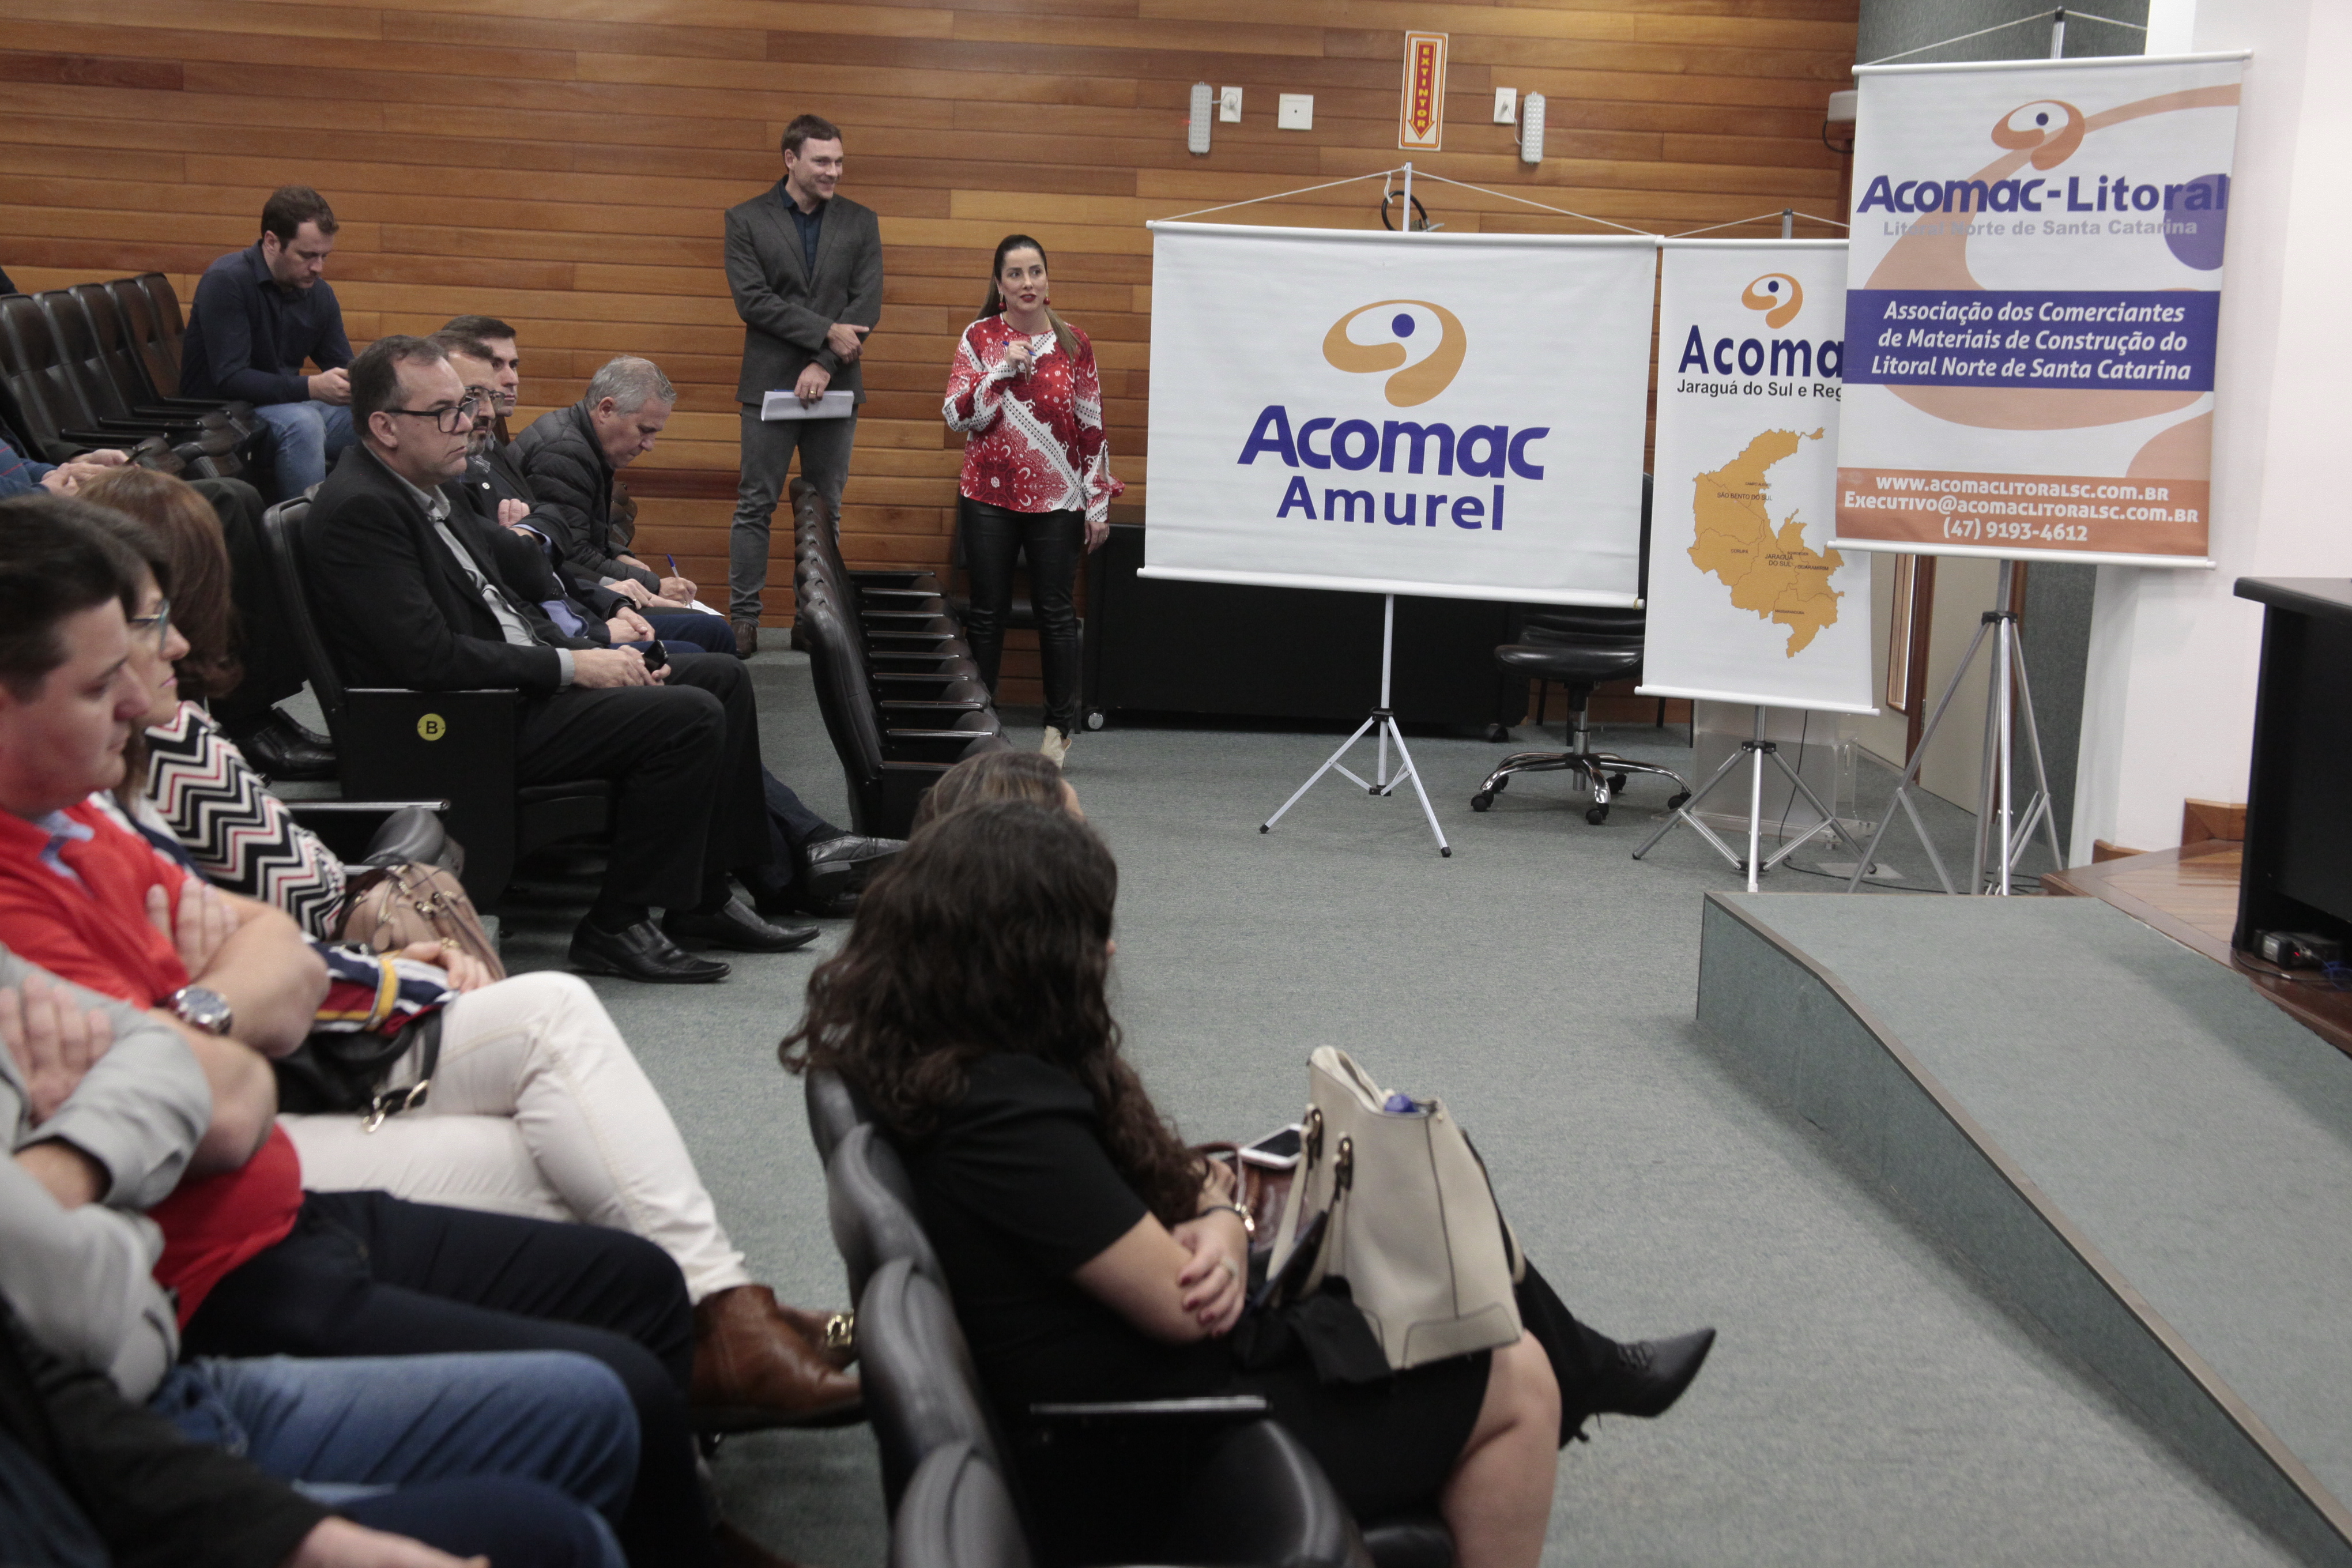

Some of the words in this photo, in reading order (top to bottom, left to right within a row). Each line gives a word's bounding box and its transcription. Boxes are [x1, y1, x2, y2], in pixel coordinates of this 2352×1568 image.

[1416, 47, 1430, 127] EXTINTOR
[1856, 174, 2227, 213] Acomac-Litoral
[1883, 221, 1944, 236] Litoral
[1951, 221, 2006, 236] Norte
[2012, 221, 2036, 235] de
[2042, 220, 2101, 235] Santa
[2108, 219, 2198, 235] Catarina
[1883, 300, 1993, 326] Associação
[1997, 301, 2034, 321] dos
[2038, 301, 2185, 322] Comerciantes
[1878, 328, 1902, 347] de
[1906, 329, 2002, 349] Materiais
[2004, 330, 2031, 349] de
[2035, 330, 2155, 356] Construção
[2159, 331, 2188, 351] do
[1871, 355, 1938, 375] Litoral
[1940, 357, 1997, 376] Norte
[2001, 357, 2026, 377] de
[2030, 359, 2092, 378] Santa
[2097, 359, 2191, 380] Catarina
[1677, 379, 1738, 398] Jaraguá
[1743, 381, 1763, 395] do
[1767, 381, 1793, 397] Sul
[1797, 386, 1807, 397] e
[1237, 405, 1551, 481] Acomac
[1276, 476, 1505, 531] Amurel
[1943, 516, 1981, 540] (47)
[1986, 521, 2088, 541] 9193-4612
[426, 721, 438, 734] B
